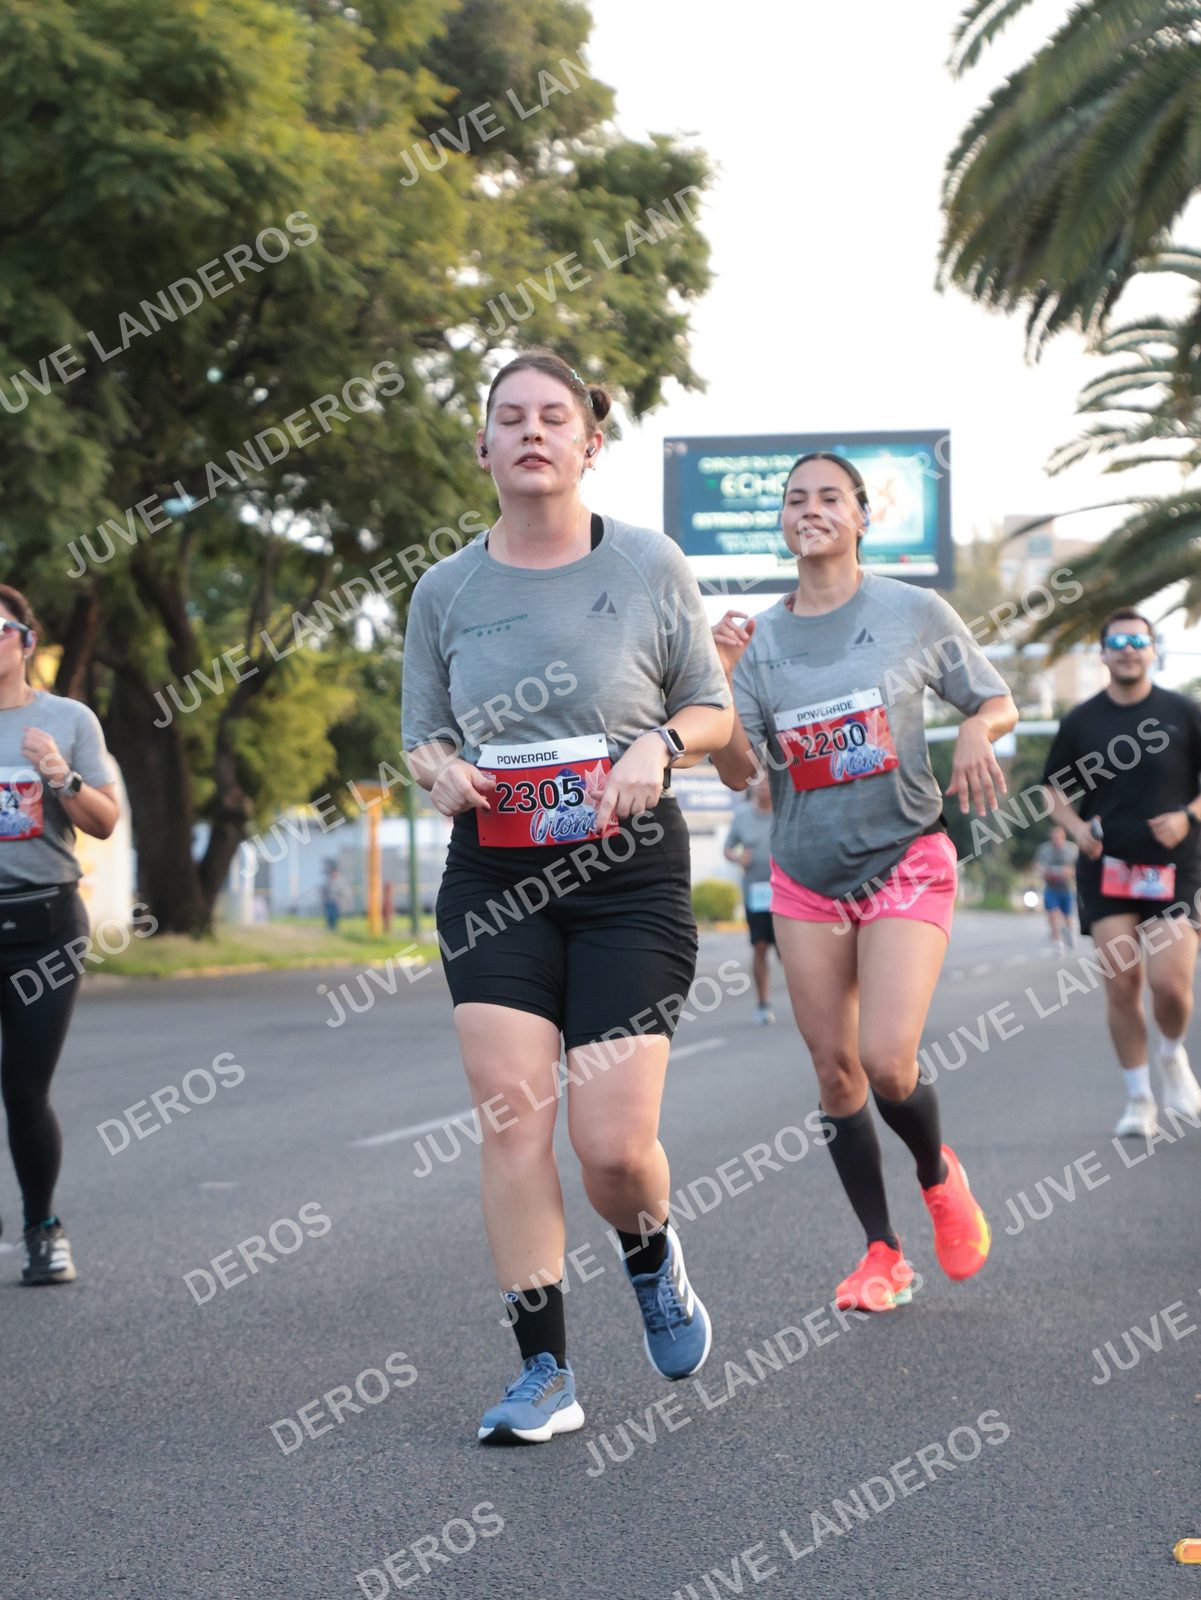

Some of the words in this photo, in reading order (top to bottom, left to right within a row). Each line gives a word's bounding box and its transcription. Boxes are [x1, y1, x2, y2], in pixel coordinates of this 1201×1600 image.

[797, 700, 854, 721] POWERADE
[800, 723, 866, 761] 2200
[497, 751, 558, 765] POWERADE
[495, 776, 584, 814] 2305
